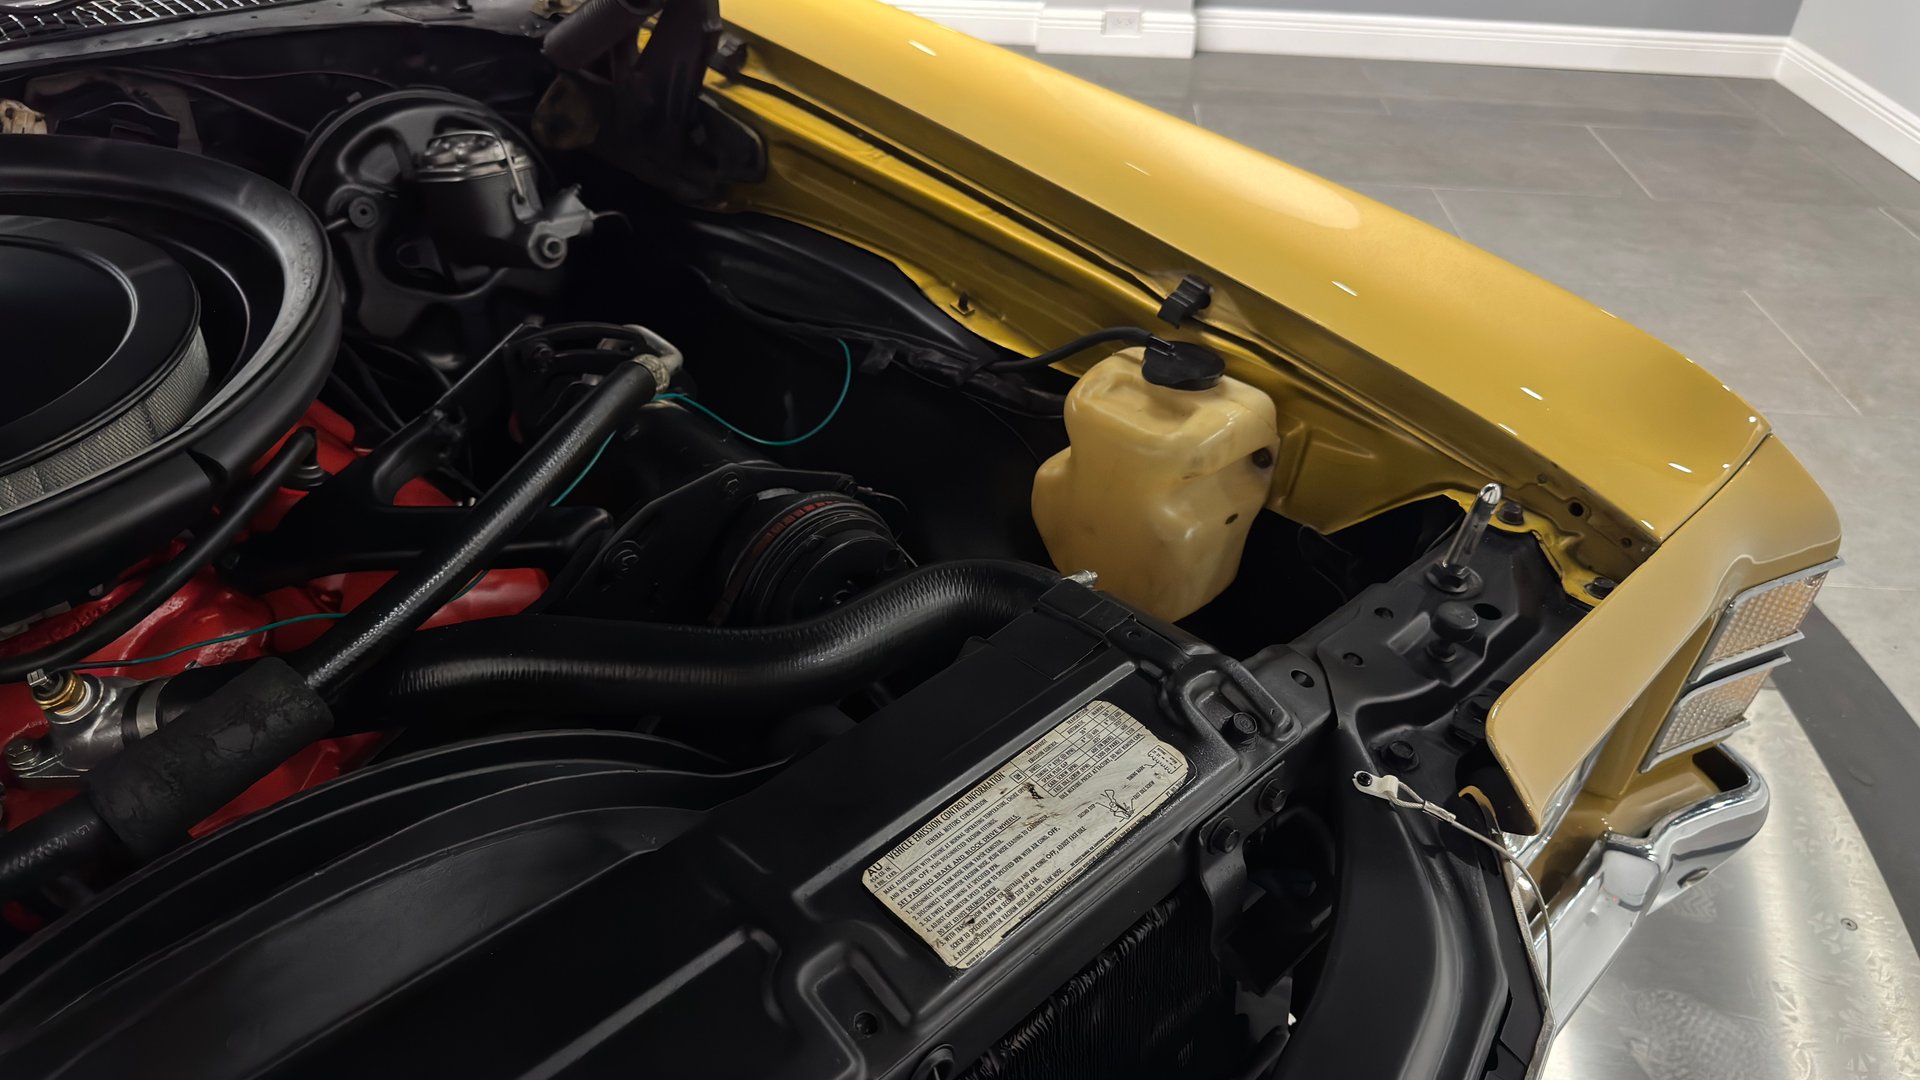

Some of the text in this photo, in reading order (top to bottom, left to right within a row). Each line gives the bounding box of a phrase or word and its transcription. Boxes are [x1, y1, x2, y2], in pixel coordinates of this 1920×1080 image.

[882, 883, 896, 895] MAKE
[893, 863, 922, 886] ADJUSTMENTS
[919, 856, 932, 867] WITH
[929, 846, 945, 859] ENGINE
[948, 831, 966, 845] NORMAL
[963, 817, 985, 834] OPERATING
[982, 799, 1009, 820] TEMPERATURE,
[886, 771, 1006, 860] VEHICLE EMISSION CONTROL INFORMATION
[924, 797, 988, 846] GENERAL MOTORS CORPORATION
[864, 861, 883, 876] AU
[889, 891, 900, 900] AND
[917, 867, 932, 879] OFF.
[929, 860, 941, 870] PLUG
[939, 840, 967, 863] DISCONNECTED
[965, 829, 981, 843] VACUUM
[979, 817, 998, 832] FITTINGS.
[896, 812, 1020, 907] SET PARKING BRAKE AND BLOCK DRIVE WHEELS.
[909, 891, 934, 911] DISCONNECT
[932, 883, 944, 893] FUEL
[941, 875, 954, 886] TANK
[952, 868, 964, 878] HOSE
[961, 860, 974, 871] FROM
[972, 851, 987, 863] VAPOR
[984, 837, 1004, 854] CANISTER.
[916, 897, 941, 917] DISCONNECT
[939, 878, 964, 899] DISTRIBUTOR
[962, 867, 980, 881] VACUUM
[987, 851, 1000, 861] PLUG
[997, 844, 1009, 854] HOSE
[1006, 833, 1024, 847] LEADING
[930, 915, 946, 929] ADJUST
[944, 897, 969, 918] CARBURETOR
[967, 888, 981, 899] SPEED
[978, 878, 992, 890] SCREW
[995, 860, 1015, 877] SPECIFIED
[1012, 854, 1023, 863] RPM
[1020, 847, 1032, 857] WITH
[1046, 825, 1061, 836] OFF.
[930, 904, 945, 917] DWELL
[943, 897, 954, 907] AND
[952, 887, 968, 900] TIMING
[971, 869, 991, 885] SPECIFIED
[988, 861, 1000, 872] RPM.
[943, 931, 956, 942] WITH
[985, 896, 998, 907] PARK
[1019, 871, 1031, 880] AND
[1045, 848, 1059, 860] OFF,
[1056, 838, 1071, 851] ADJUST
[1068, 832, 1079, 841] FAST
[1076, 825, 1087, 834] IDLE
[943, 921, 954, 930] NOT
[951, 909, 968, 923] ADJUST
[965, 895, 985, 912] SOLENOID
[983, 885, 998, 897] SCREW.
[949, 936, 965, 950] SCREW
[968, 916, 989, 934] SPECIFIED
[986, 910, 997, 919] RPM
[1014, 887, 1024, 896] STEP
[977, 917, 1003, 939] DISTRIBUTOR
[1001, 904, 1018, 919] VACUUM
[1015, 896, 1028, 907] HOSE
[1025, 889, 1036, 899] AND
[1033, 883, 1044, 893] FUEL
[1042, 875, 1053, 885] TANK
[1051, 867, 1064, 878] HOSE.
